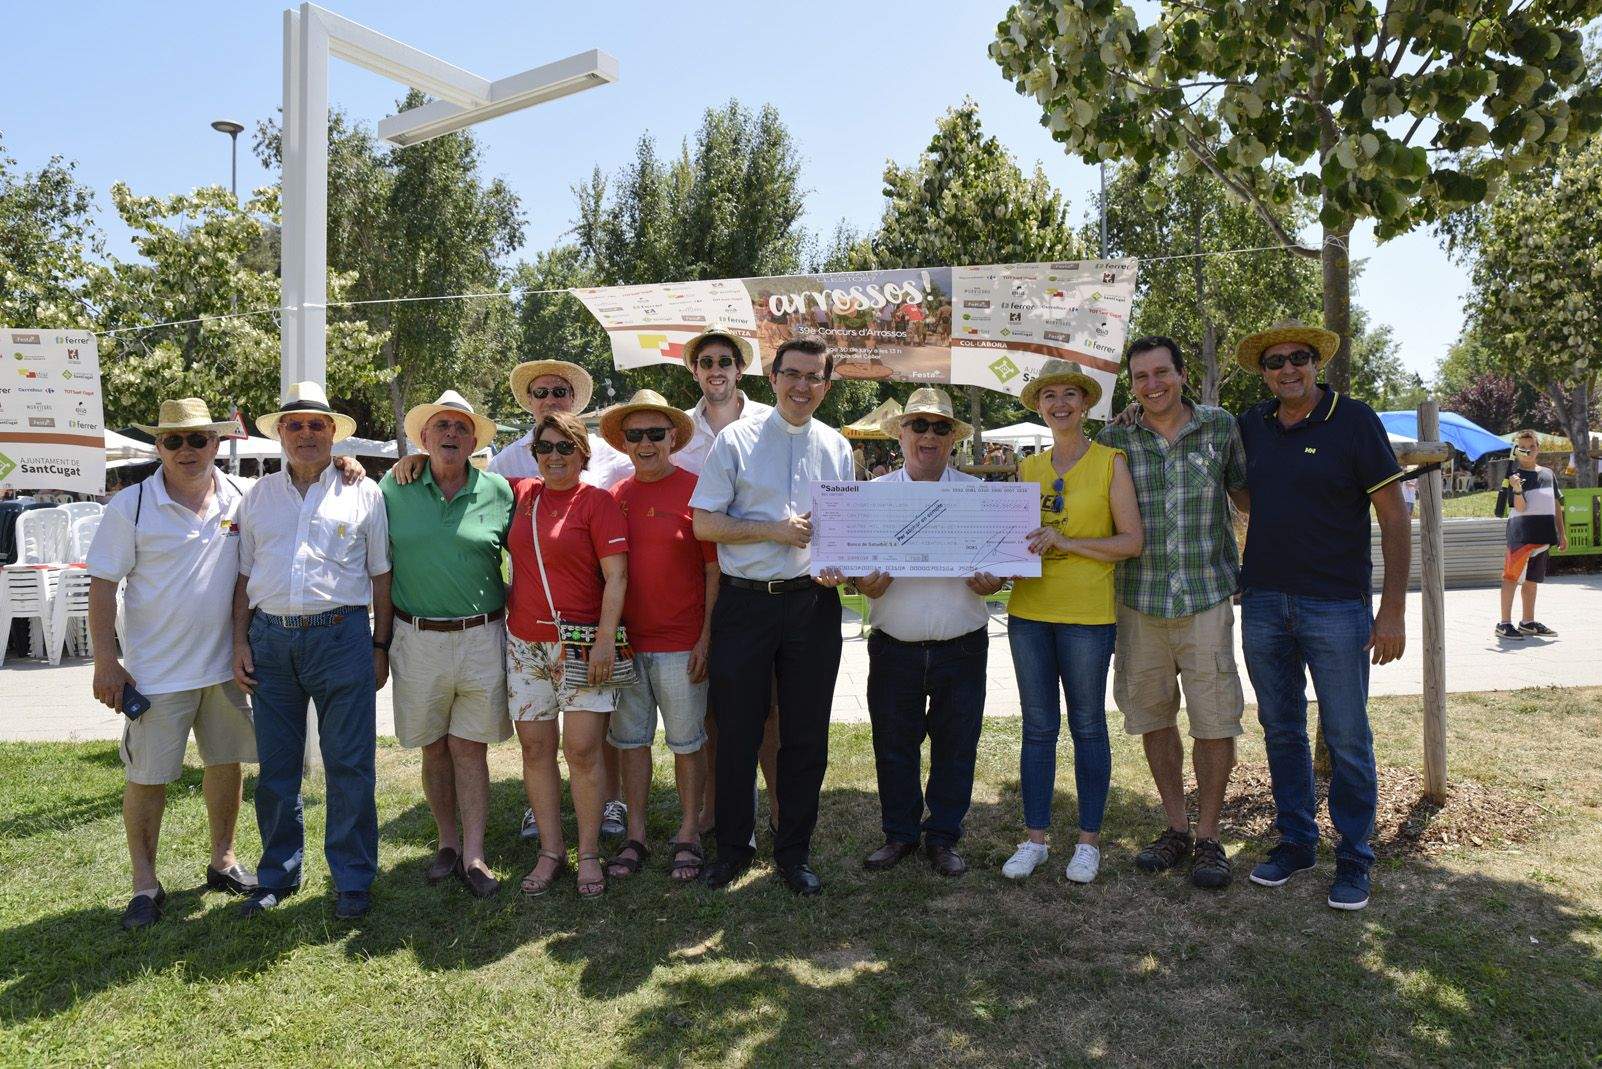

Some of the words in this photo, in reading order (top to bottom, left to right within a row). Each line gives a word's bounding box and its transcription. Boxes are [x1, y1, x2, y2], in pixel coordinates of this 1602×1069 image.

[768, 270, 934, 317] arrossos!
[1010, 302, 1036, 310] ferrer
[818, 327, 857, 336] Concurs
[858, 328, 907, 338] d'Arrossos
[65, 336, 89, 344] ferrer
[1093, 340, 1116, 354] ferrer
[912, 371, 935, 379] Festa
[77, 421, 98, 429] ferrer
[20, 457, 69, 465] AJUNTAMENT
[21, 464, 80, 477] SantCugat
